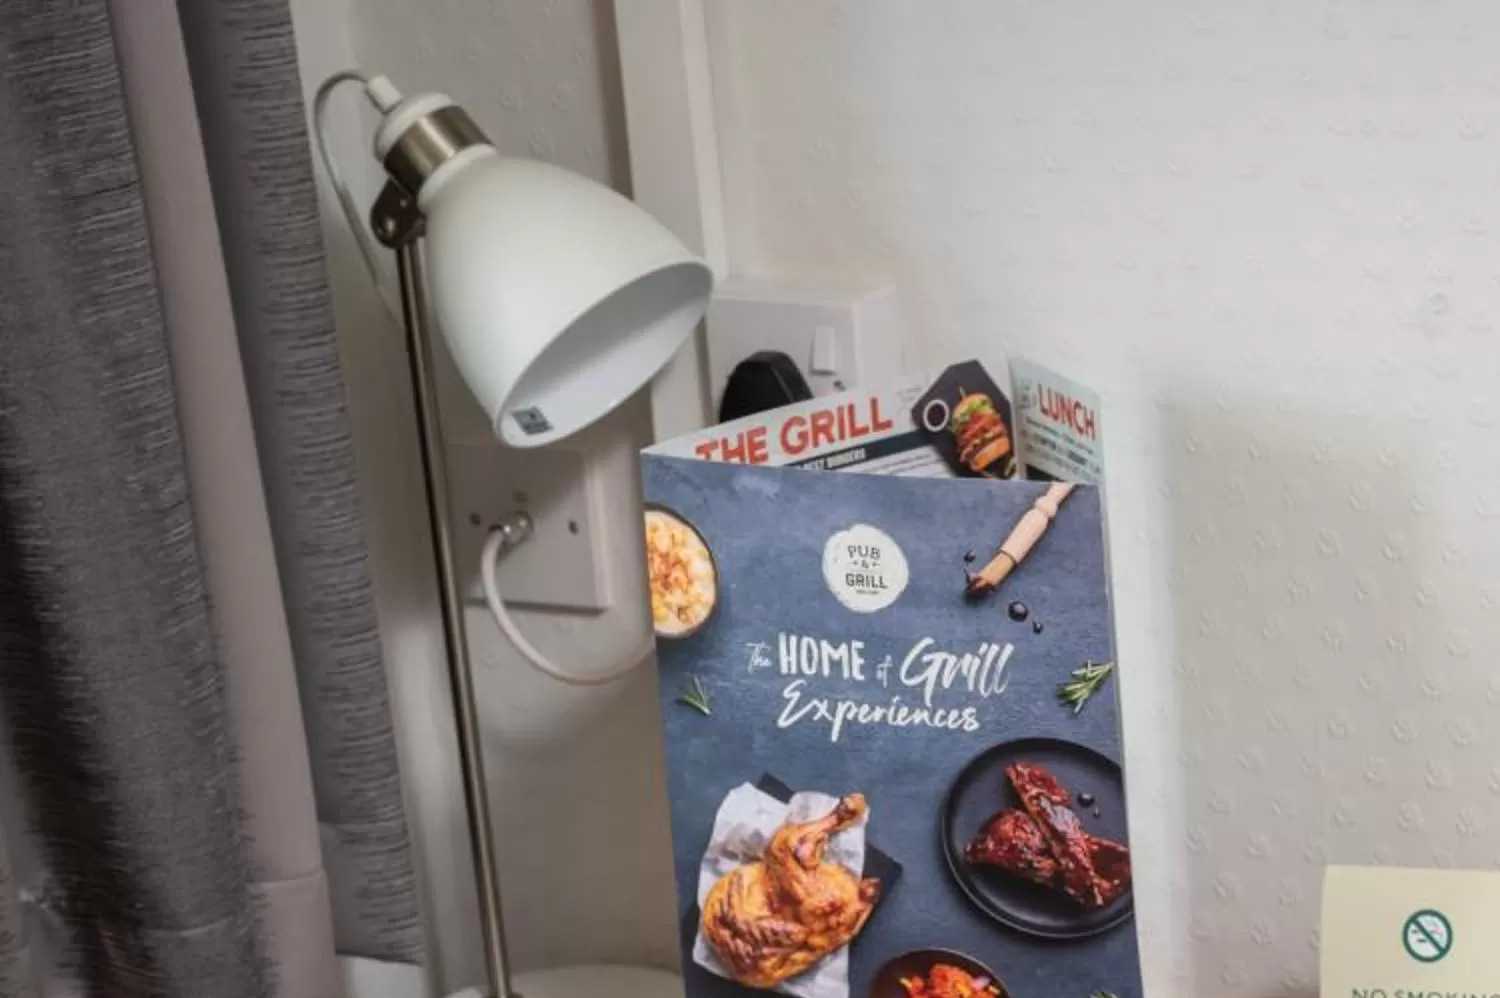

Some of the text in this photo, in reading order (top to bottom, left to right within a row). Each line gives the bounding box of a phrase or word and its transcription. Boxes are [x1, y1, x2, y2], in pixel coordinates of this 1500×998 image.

[695, 396, 894, 464] THE GRILL
[1037, 383, 1096, 442] LUNCH
[845, 572, 889, 589] GRILL
[847, 544, 881, 560] PUB
[860, 559, 870, 569] &
[745, 641, 773, 674] The
[778, 631, 866, 682] HOME
[900, 636, 1016, 706] Grill
[776, 679, 981, 743] Experiences
